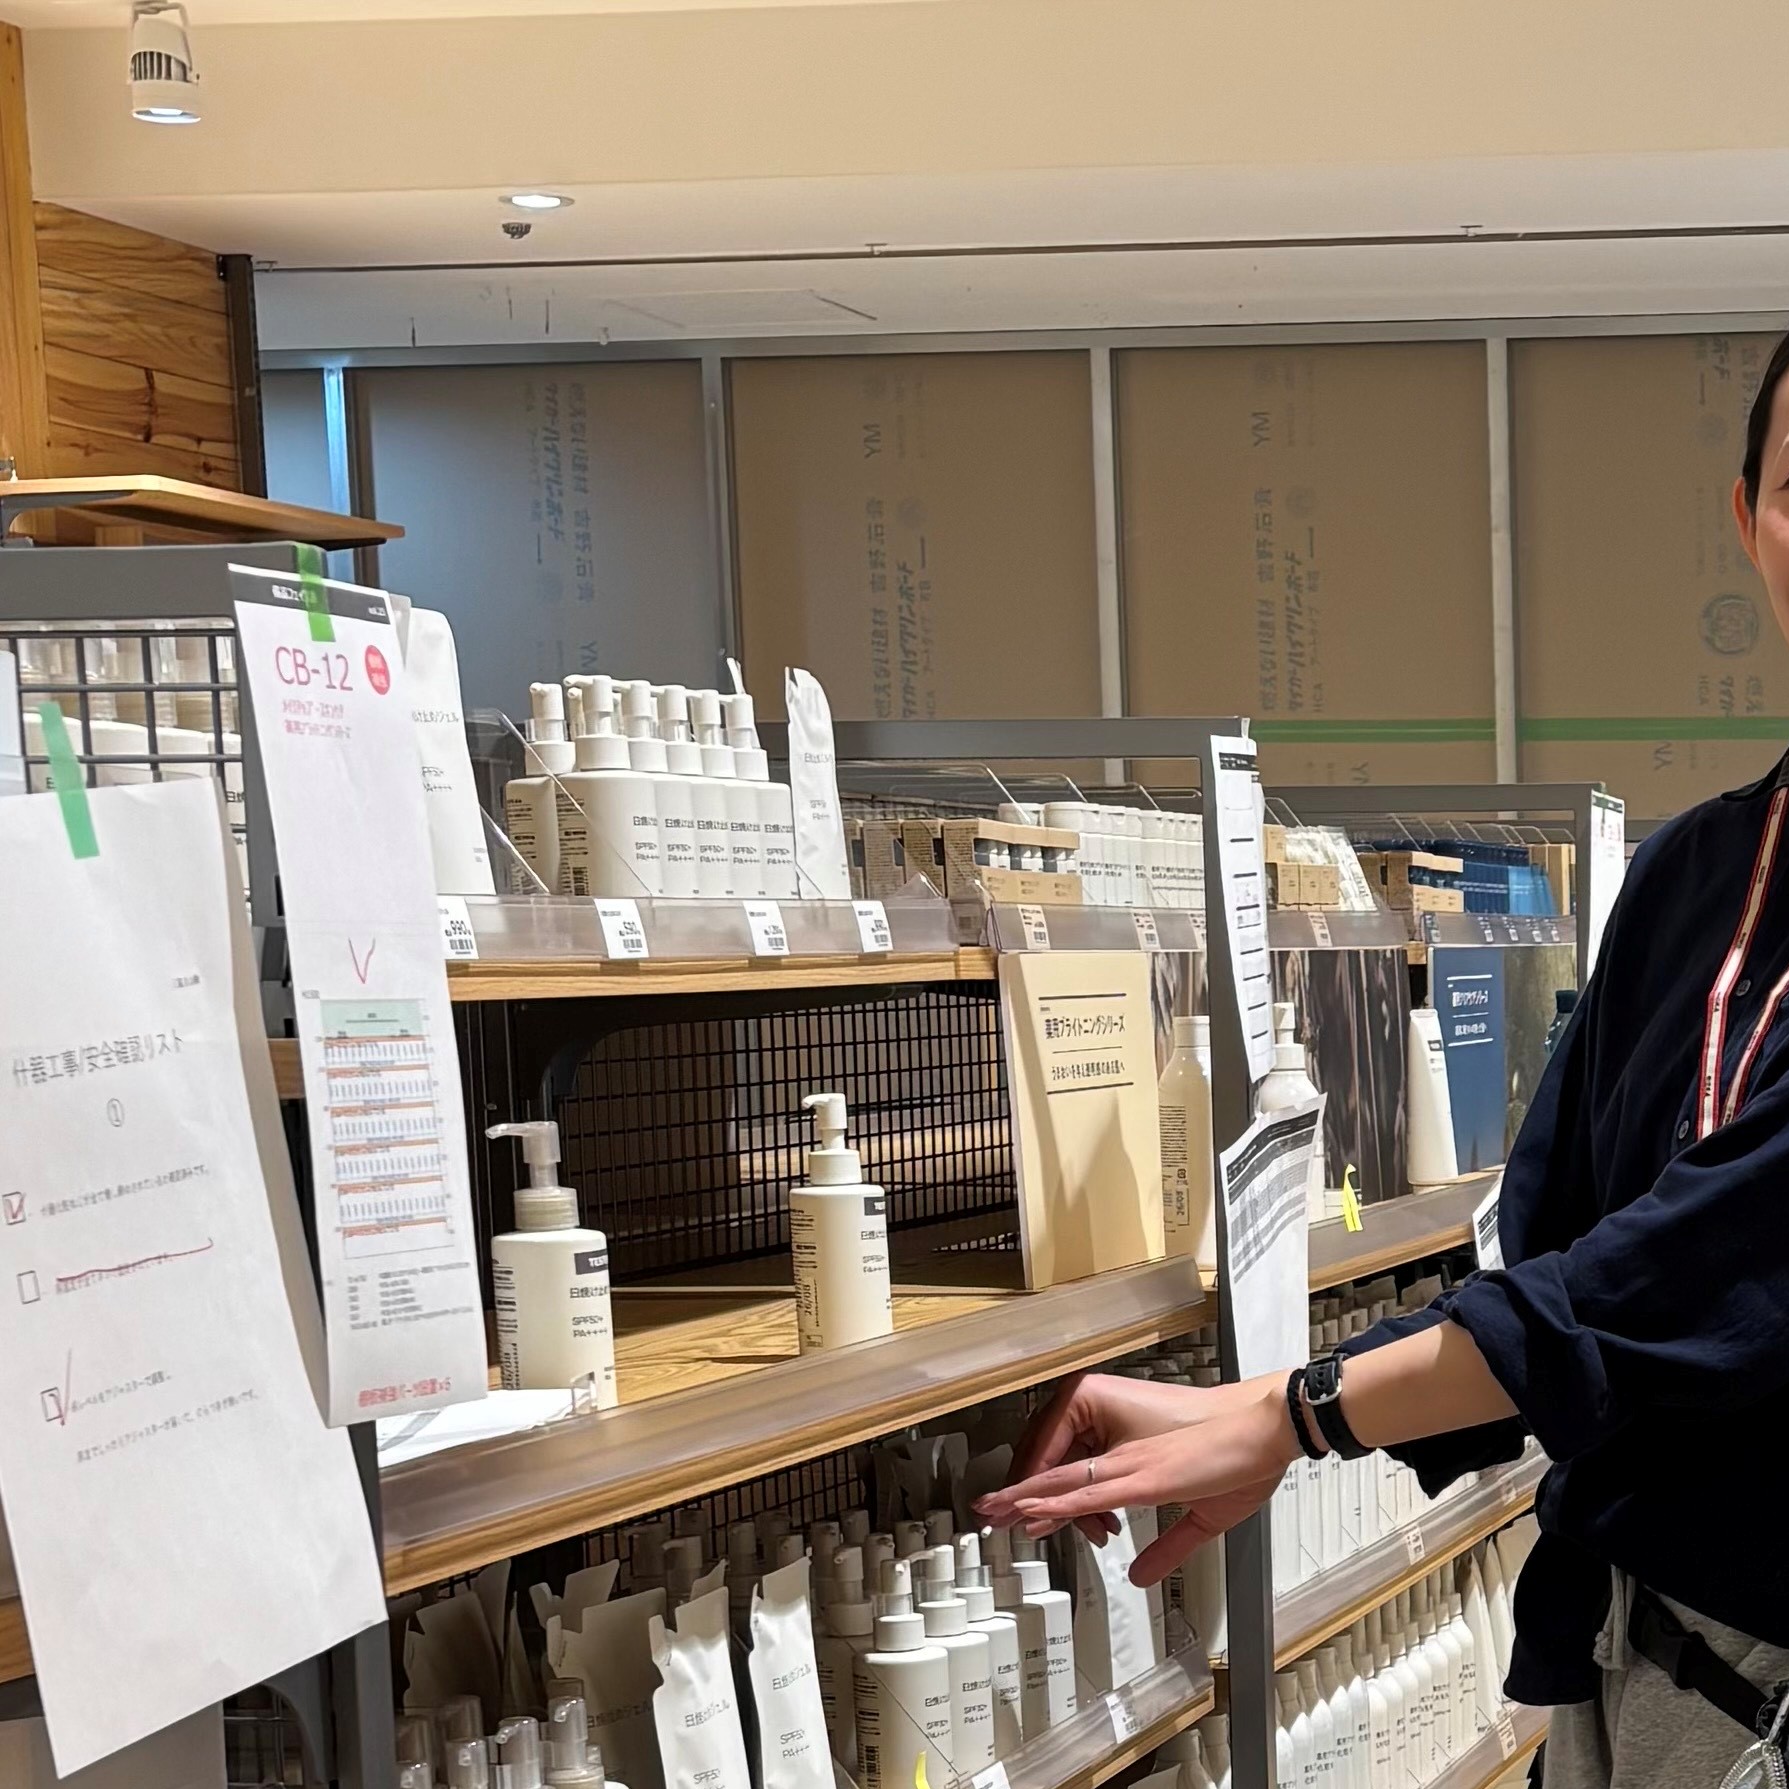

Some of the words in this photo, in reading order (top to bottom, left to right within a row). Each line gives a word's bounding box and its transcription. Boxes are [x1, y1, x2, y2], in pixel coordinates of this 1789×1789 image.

[863, 423, 882, 459] YM
[1251, 411, 1271, 447] YM
[275, 645, 353, 691] CB-12
